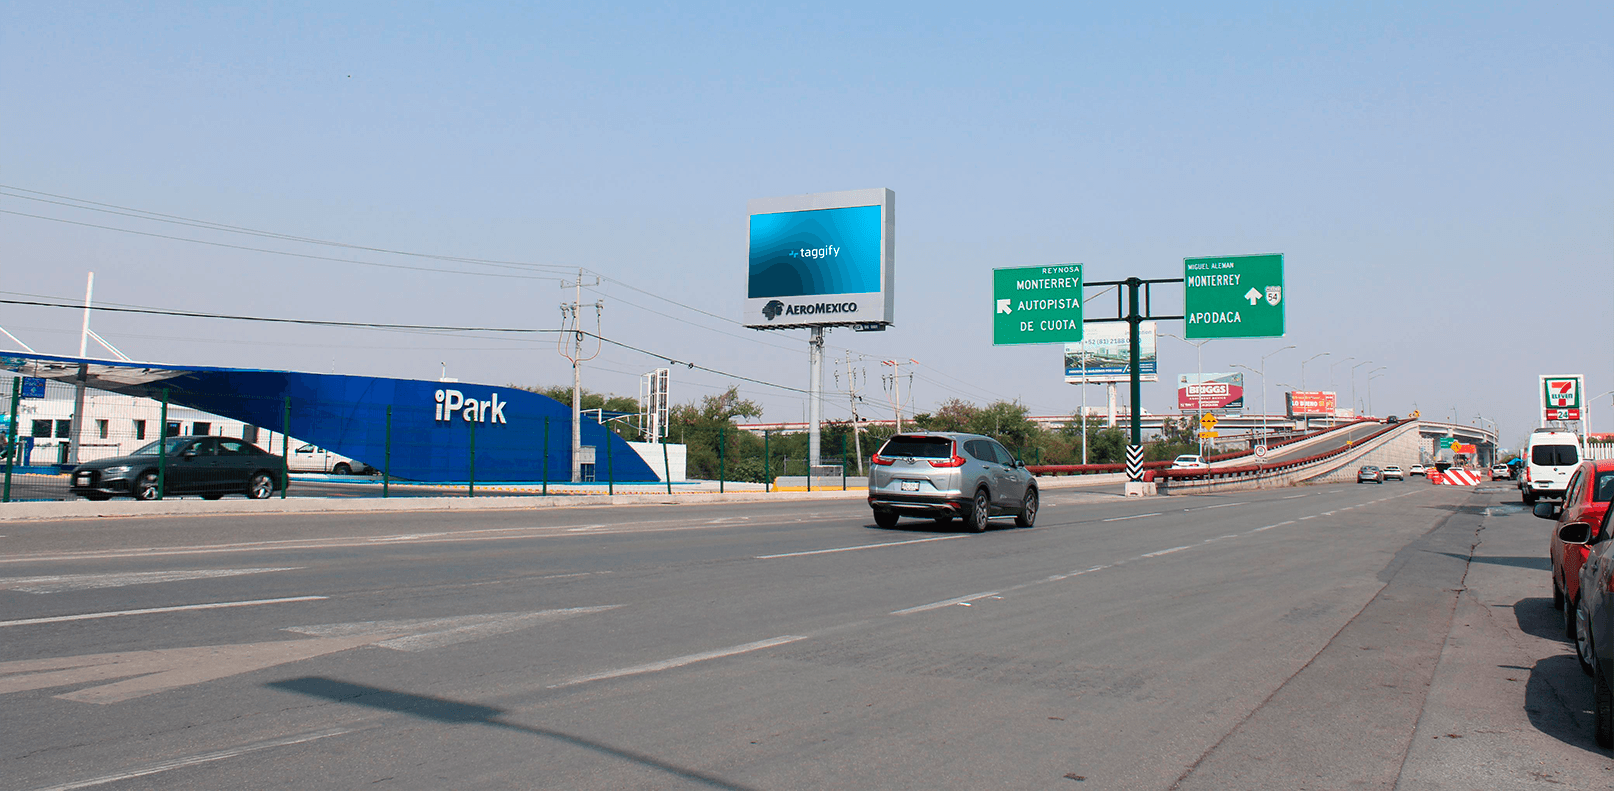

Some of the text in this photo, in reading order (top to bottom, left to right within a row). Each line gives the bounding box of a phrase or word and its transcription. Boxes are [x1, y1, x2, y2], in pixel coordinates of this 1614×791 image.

[800, 245, 841, 260] taggify
[1042, 266, 1080, 275] REYNOSA
[1016, 277, 1080, 290] MONTERREY
[1188, 274, 1241, 287] MONTERREY
[1268, 293, 1278, 302] 54
[785, 302, 858, 315] AEROMEXICO
[1017, 298, 1080, 311] AUTOPISTA
[1188, 311, 1242, 324] APODACA
[1020, 319, 1077, 332] DE CUOTA
[1189, 385, 1226, 394] BRIGGS
[434, 389, 507, 424] iPark
[1558, 411, 1569, 419] 24
